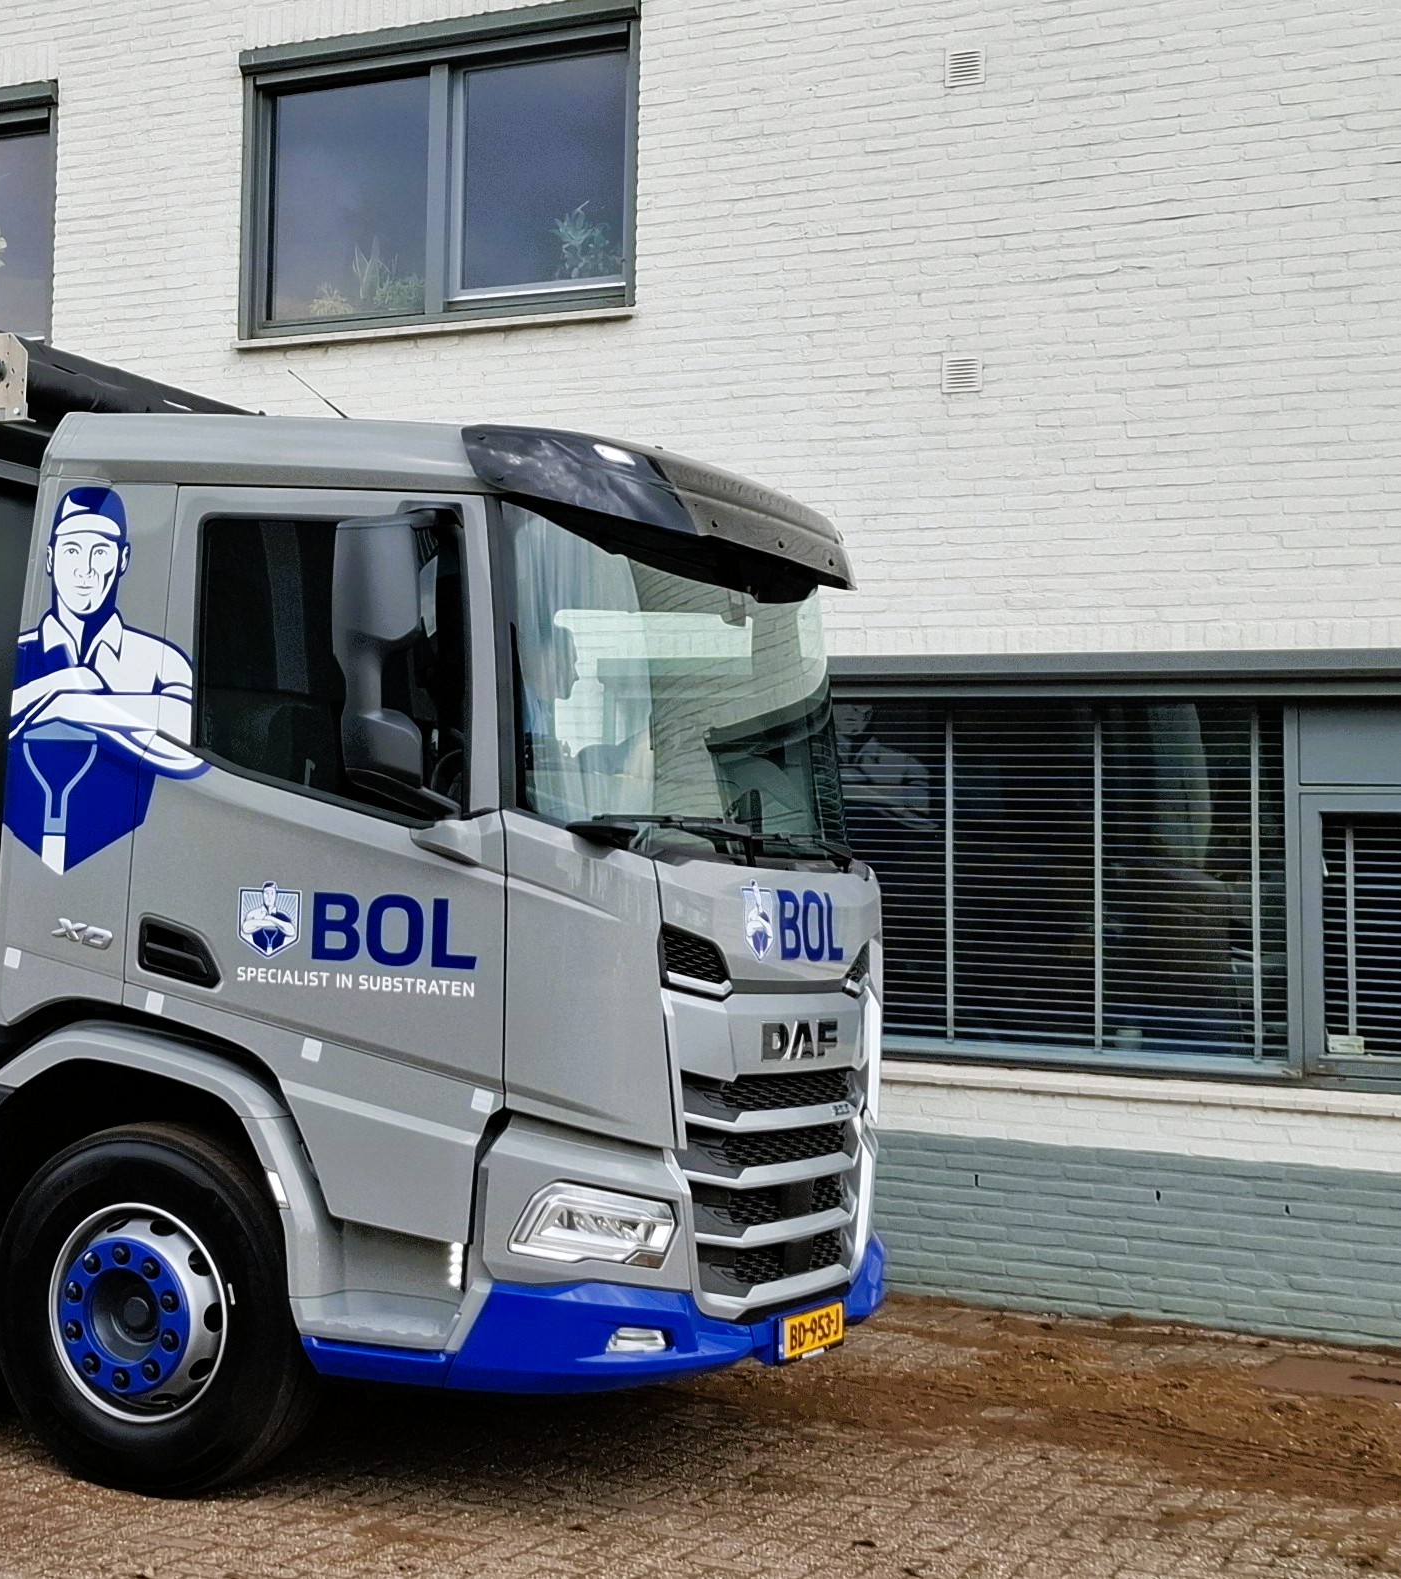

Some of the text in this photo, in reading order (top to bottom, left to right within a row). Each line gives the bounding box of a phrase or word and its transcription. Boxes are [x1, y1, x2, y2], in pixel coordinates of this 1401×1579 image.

[311, 891, 478, 970] BOL
[776, 888, 844, 962] BOL
[236, 966, 476, 998] SPECIALIST IN SUBSTRATEN
[760, 1017, 838, 1062] DAF
[789, 1307, 840, 1352] BD-953-J
